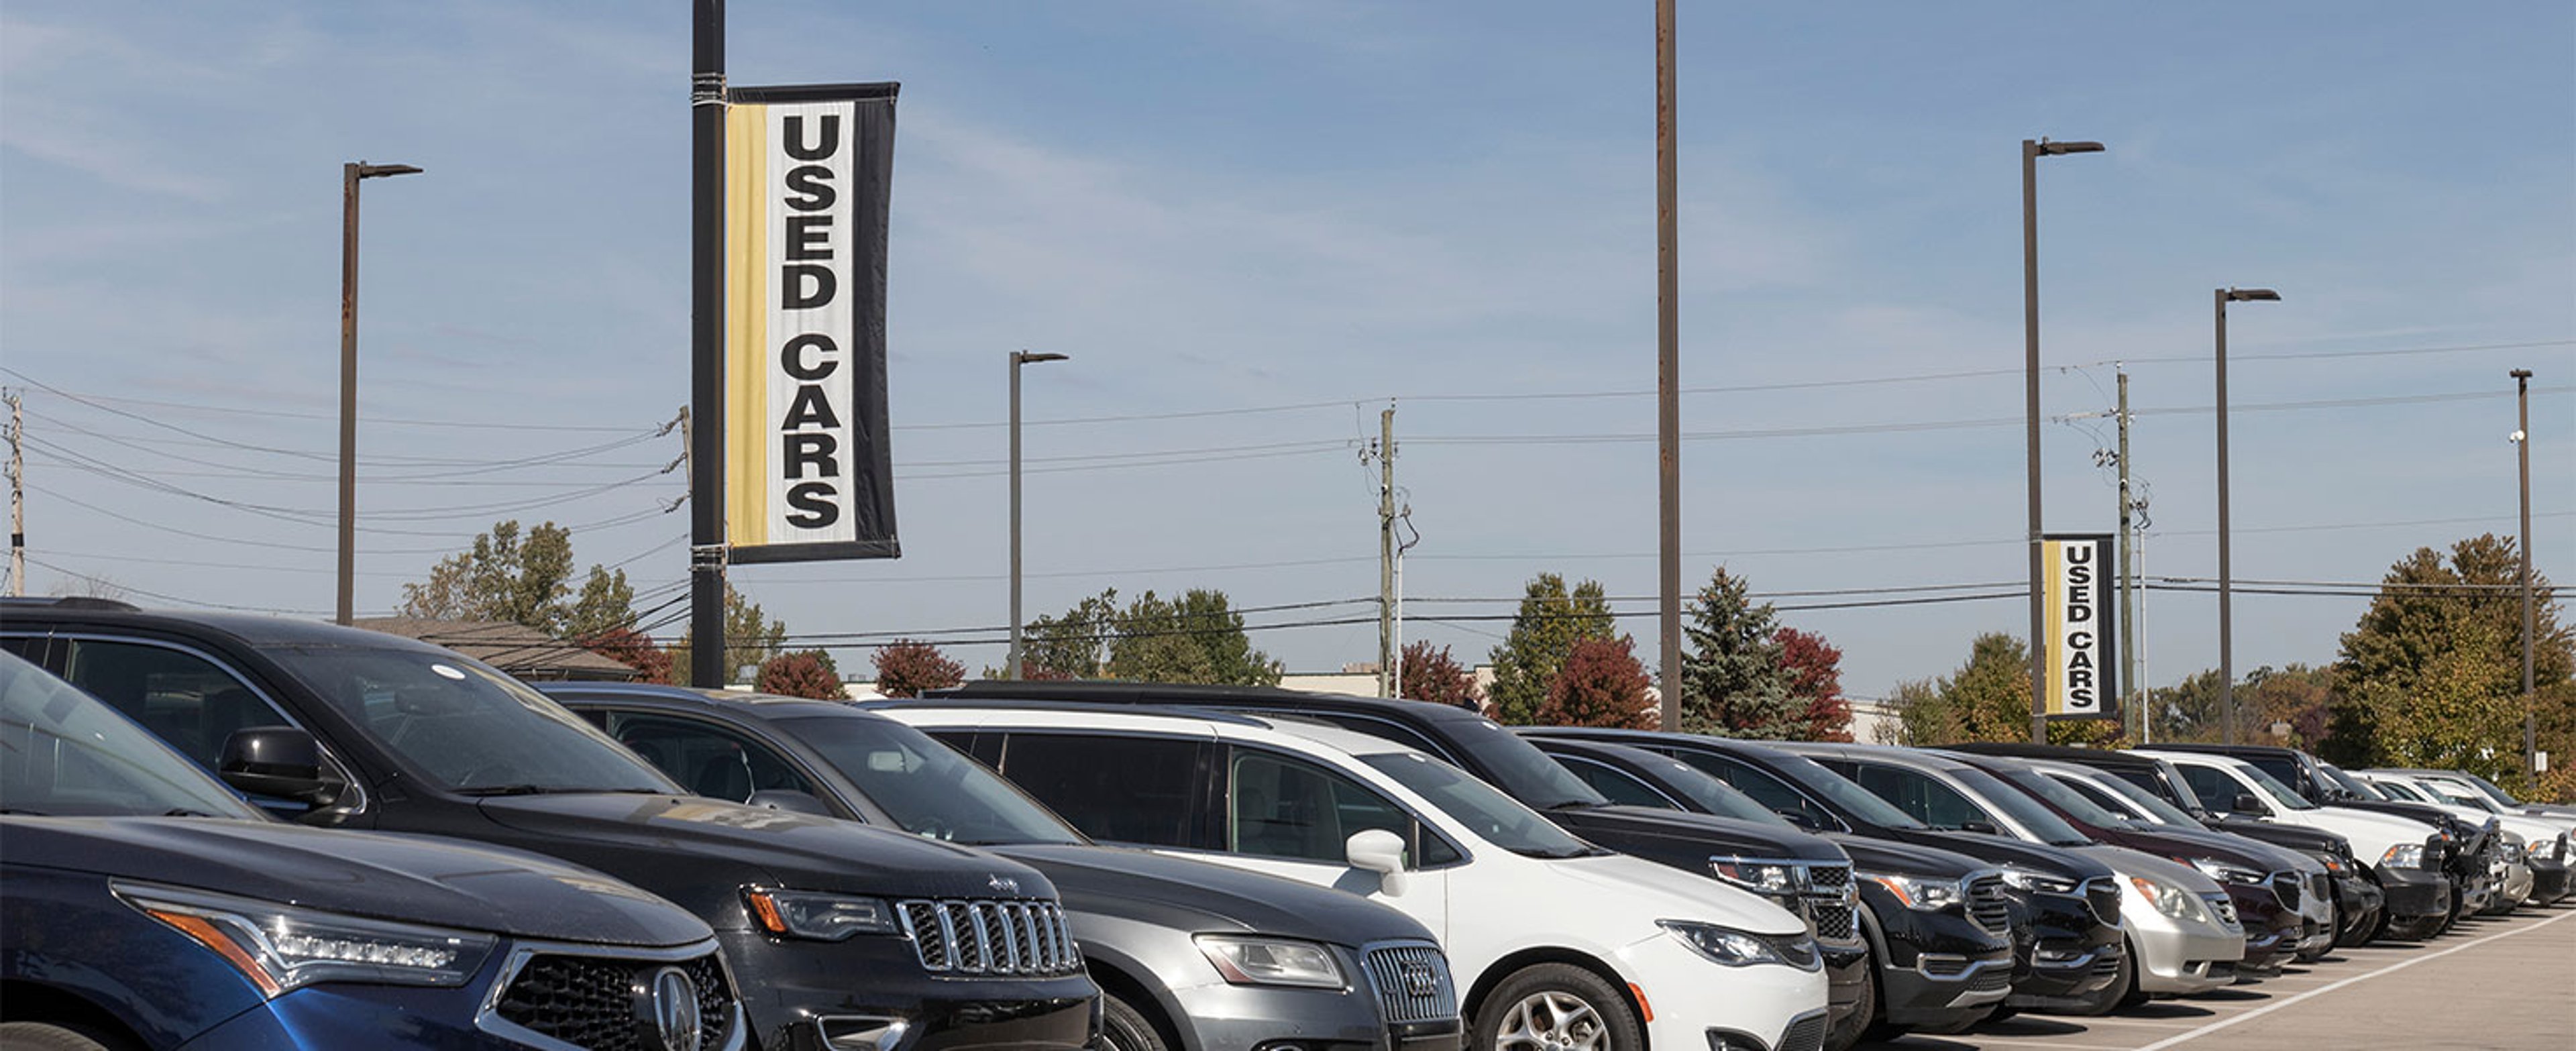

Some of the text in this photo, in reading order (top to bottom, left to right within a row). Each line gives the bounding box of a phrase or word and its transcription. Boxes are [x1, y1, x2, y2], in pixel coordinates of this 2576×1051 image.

[781, 115, 841, 529] USED CARS
[2067, 546, 2093, 708] USED CARS
